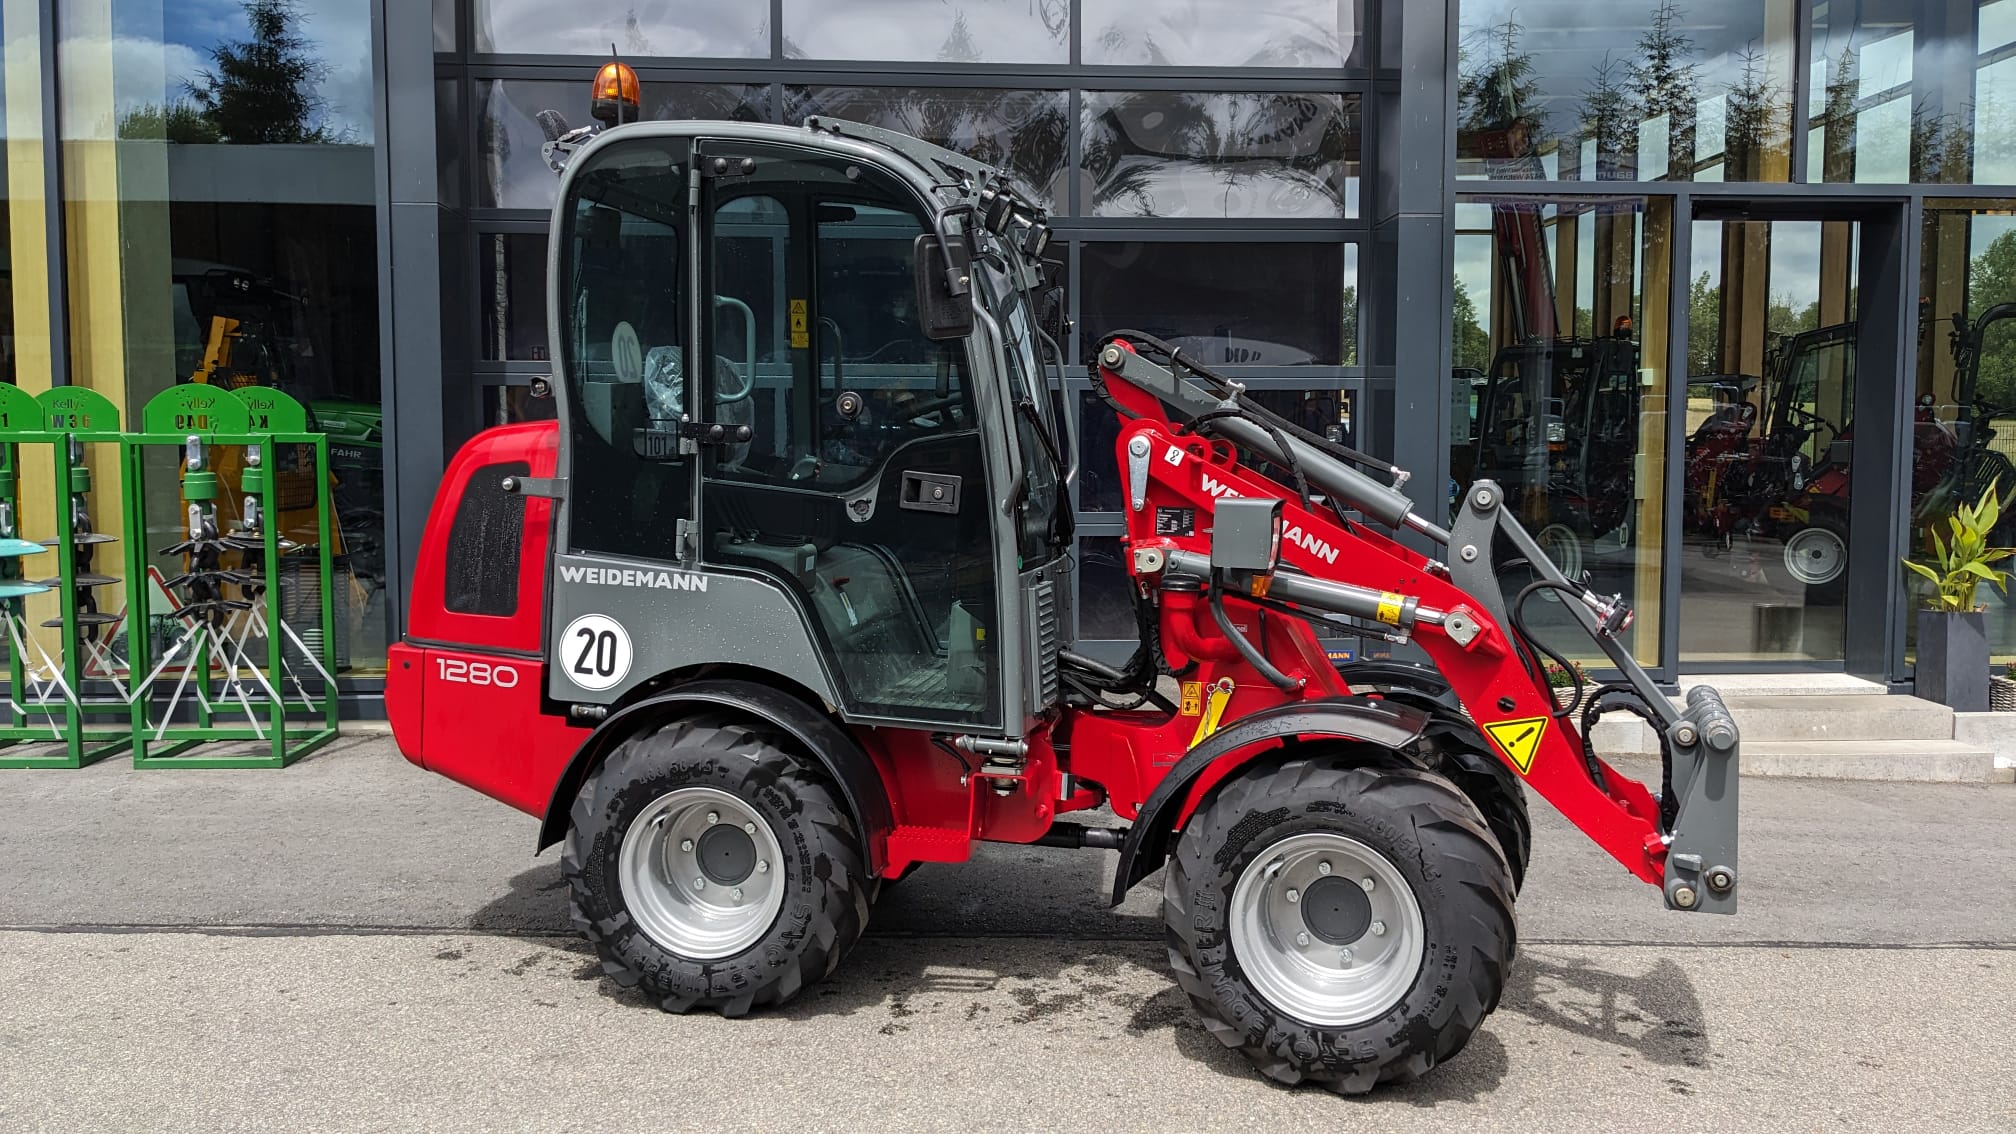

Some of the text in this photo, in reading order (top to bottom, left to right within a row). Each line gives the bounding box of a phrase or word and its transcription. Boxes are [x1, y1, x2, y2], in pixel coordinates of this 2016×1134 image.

[53, 398, 80, 410] Kelly
[559, 565, 709, 593] WEIDEMANN
[573, 627, 618, 678] 20
[436, 657, 519, 688] 1280
